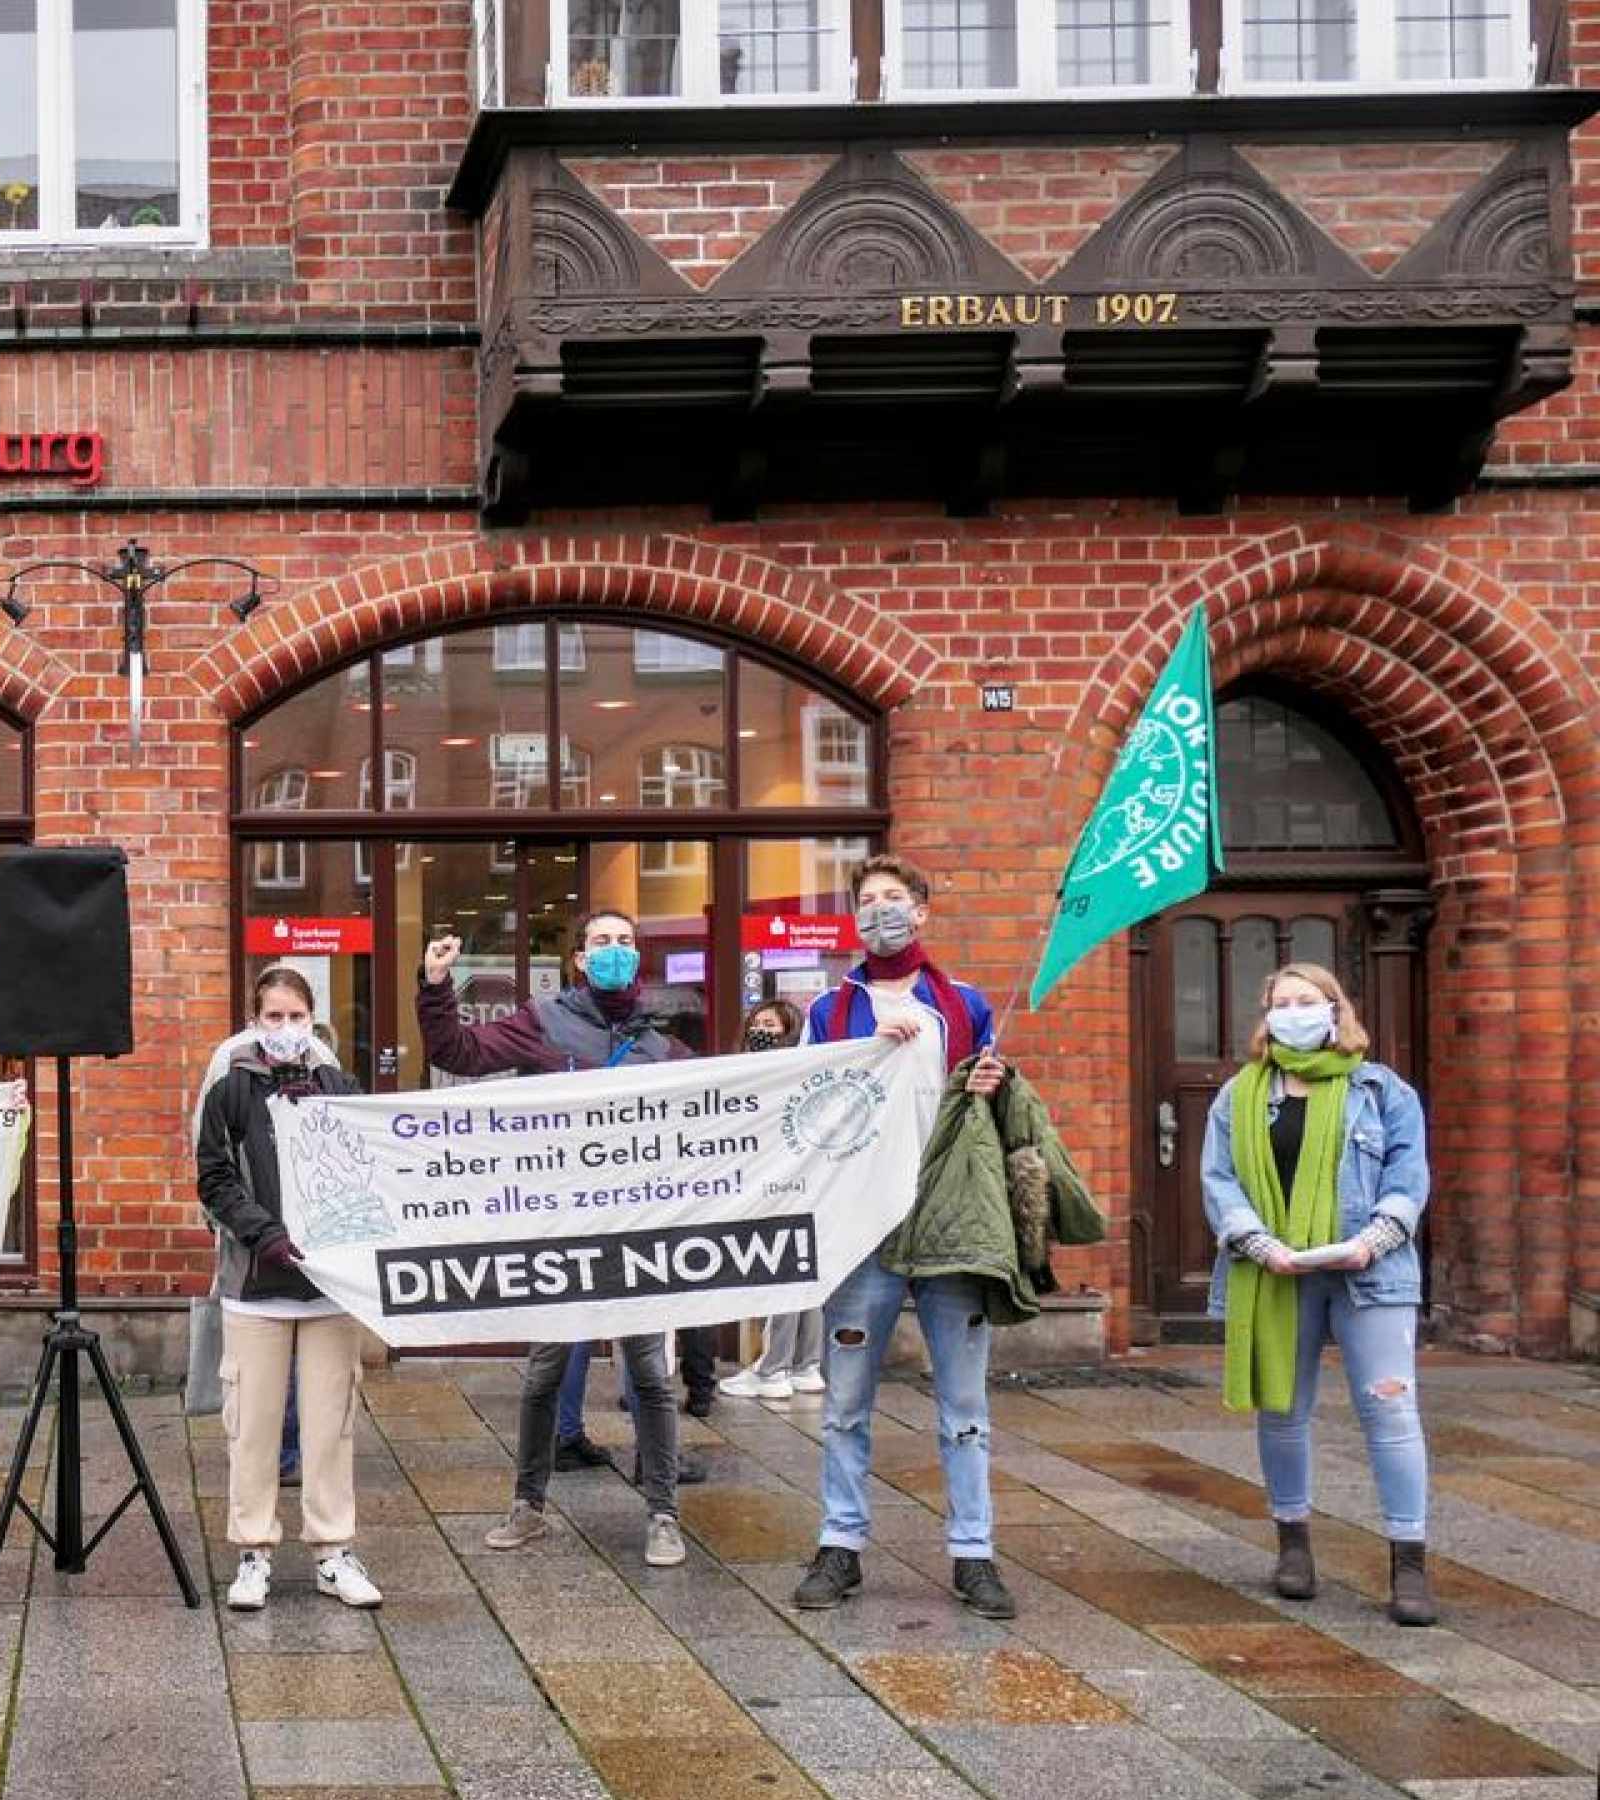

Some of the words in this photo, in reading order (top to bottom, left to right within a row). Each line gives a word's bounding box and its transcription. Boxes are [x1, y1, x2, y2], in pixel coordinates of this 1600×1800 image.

[901, 295, 1069, 325] ERBAUT
[292, 925, 341, 938] Sparkasse
[790, 923, 840, 935] Sparkasse
[392, 1111, 473, 1139] Geld
[489, 1108, 571, 1133] kann
[585, 1097, 668, 1126] nicht
[682, 1089, 760, 1117] alles
[426, 1150, 500, 1178] aber
[516, 1145, 566, 1172] mit
[580, 1135, 661, 1168] Geld
[677, 1133, 759, 1159] kann
[402, 1197, 471, 1220] man
[485, 1186, 558, 1215] alles
[573, 1169, 742, 1208] zerstören!
[385, 1248, 603, 1307] DIVEST
[626, 1228, 813, 1289] NOW!
